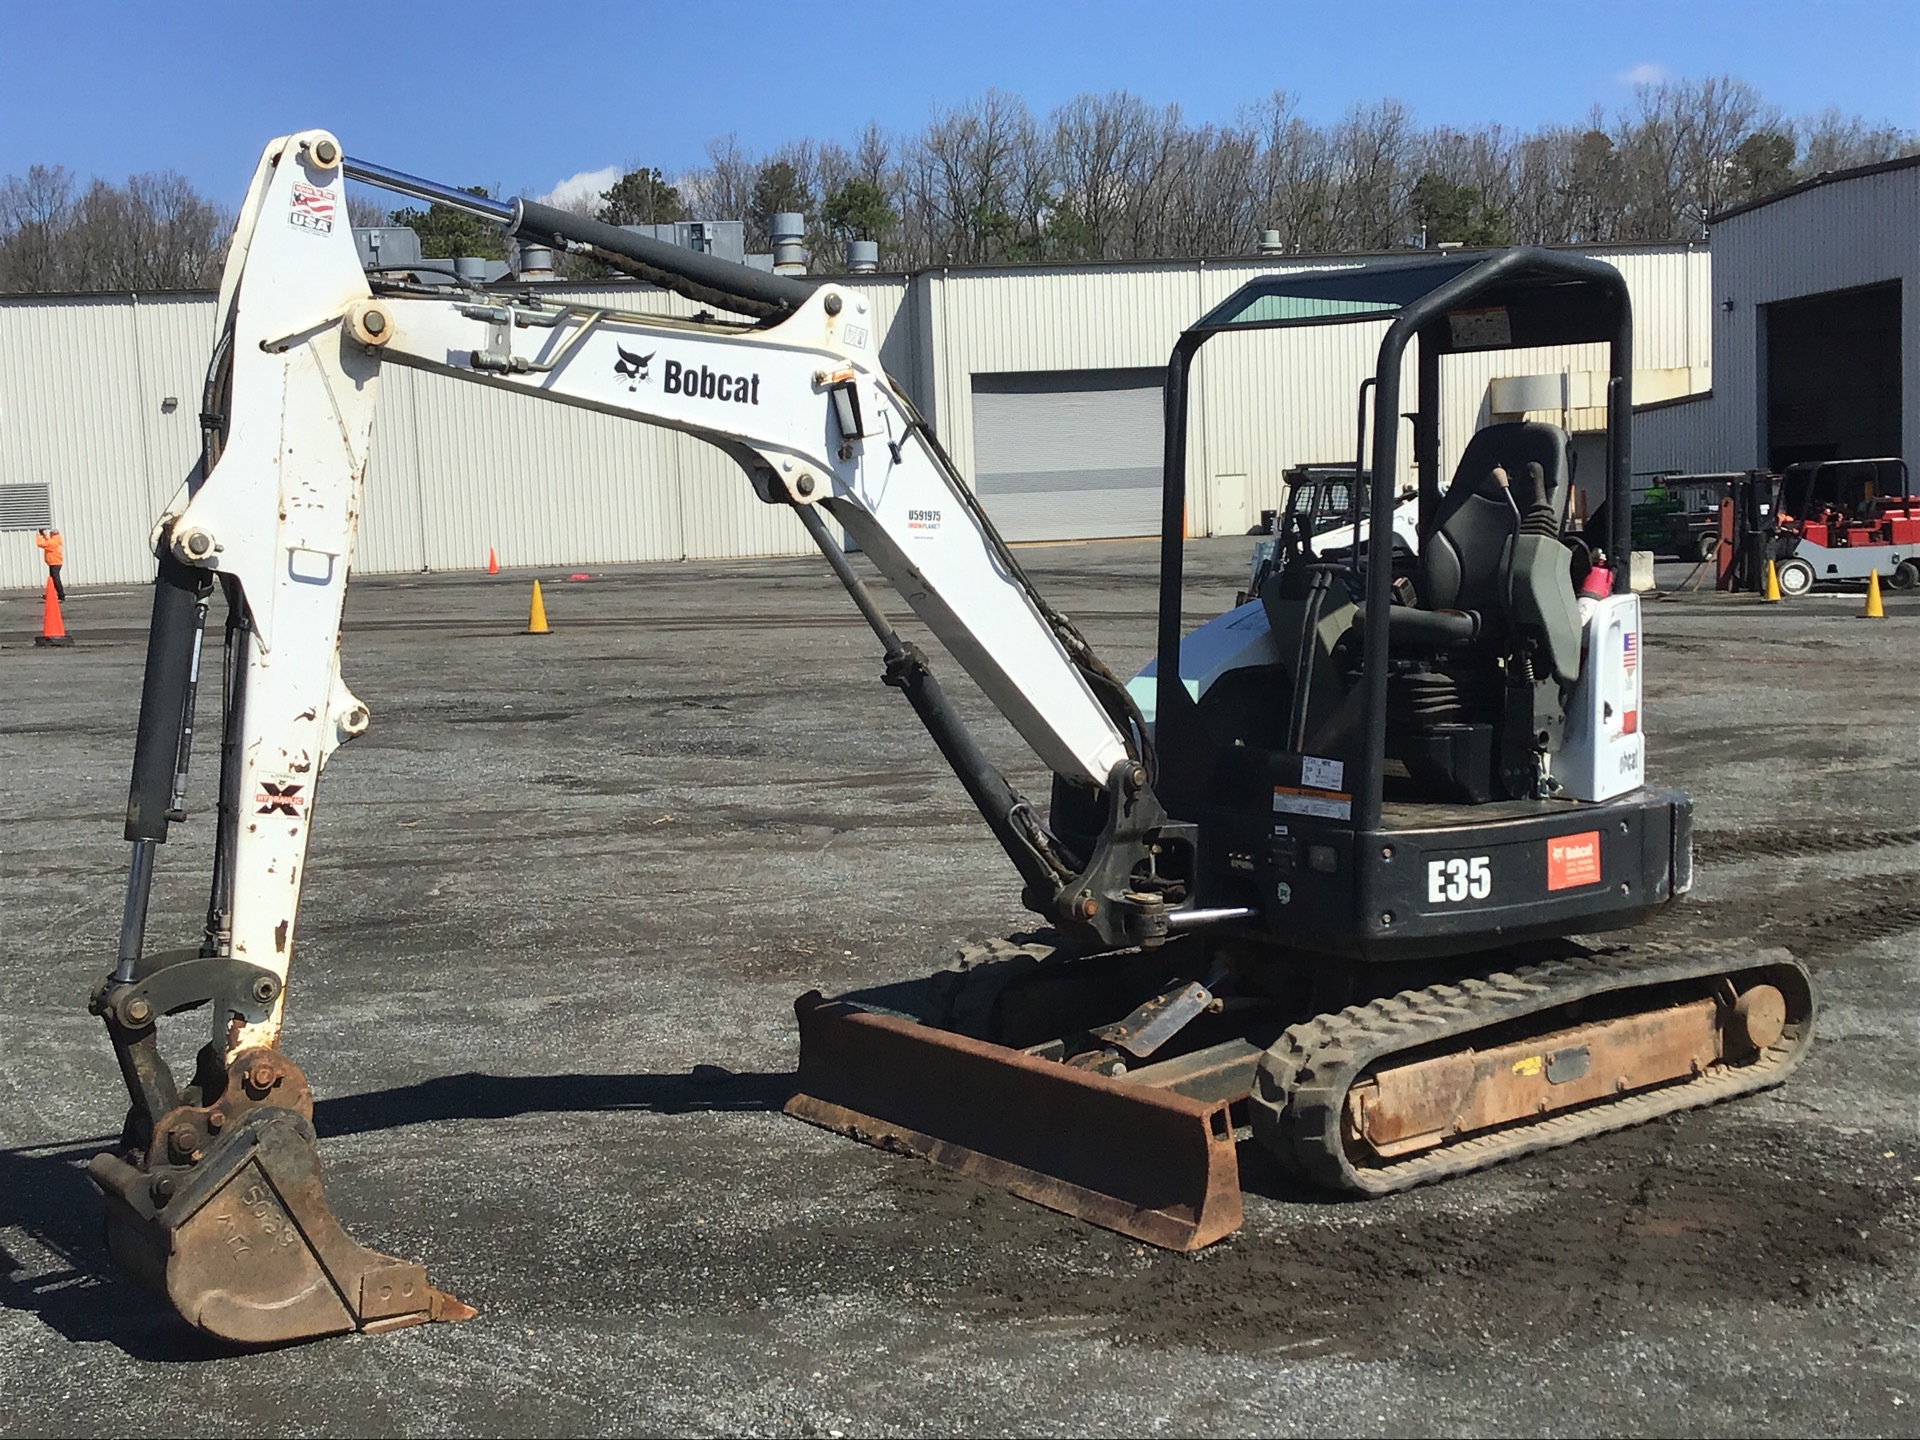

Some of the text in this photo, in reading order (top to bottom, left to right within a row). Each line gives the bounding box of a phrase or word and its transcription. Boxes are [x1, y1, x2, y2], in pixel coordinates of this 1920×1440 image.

[292, 213, 329, 232] USA
[664, 359, 760, 406] Bobcat
[908, 509, 941, 522] U591975
[1428, 856, 1491, 904] E35
